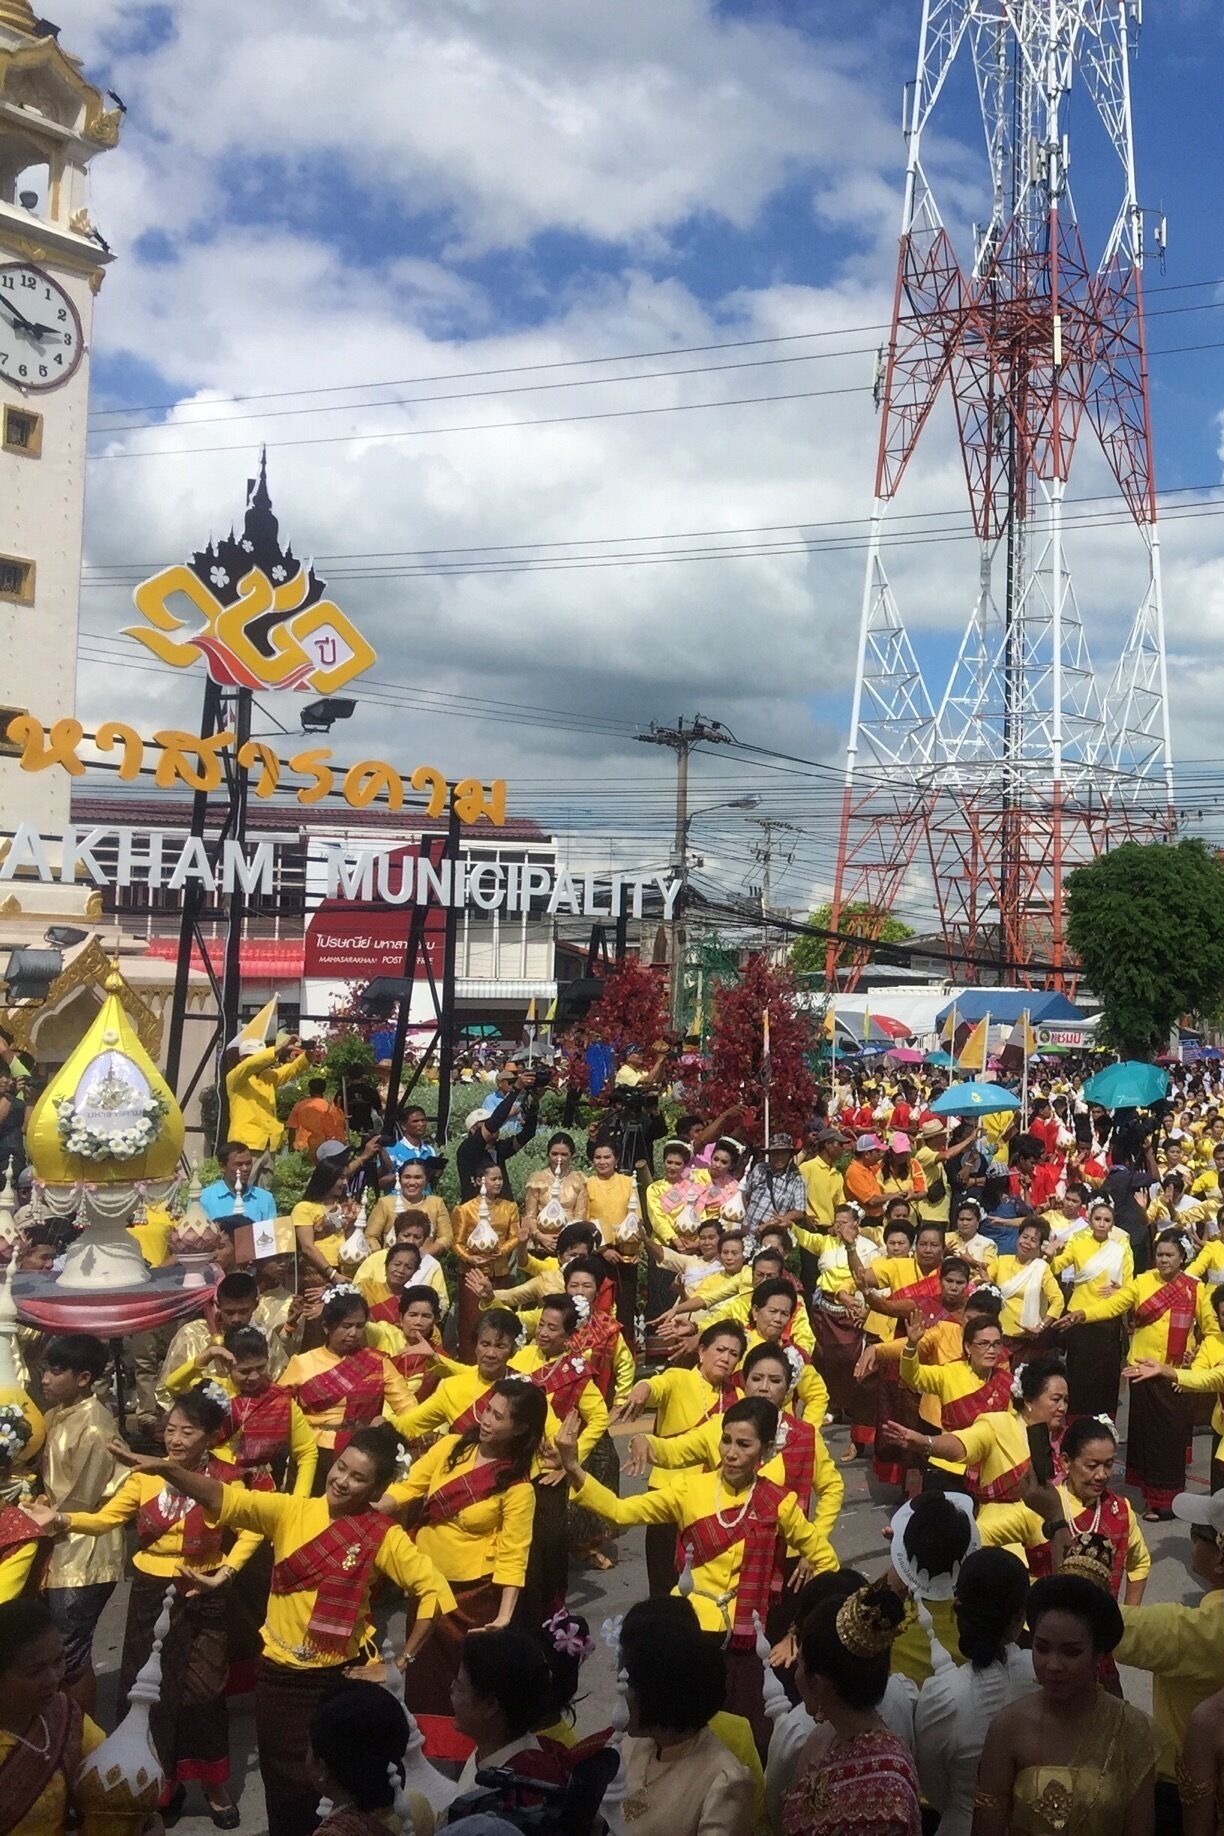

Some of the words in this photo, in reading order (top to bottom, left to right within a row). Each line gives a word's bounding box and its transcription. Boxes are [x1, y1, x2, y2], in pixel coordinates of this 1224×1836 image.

[2, 275, 14, 290] 11
[20, 274, 37, 290] 12
[45, 288, 51, 301] 1
[57, 308, 67, 322] 2
[64, 333, 72, 346] 3
[54, 353, 63, 365] 4
[19, 364, 28, 377] 6
[39, 365, 48, 377] 5
[0, 822, 274, 895] AKHAM
[327, 846, 684, 920] MUNICIPALITY
[316, 933, 372, 949] ไปรษณีย์
[382, 956, 403, 964] POST
